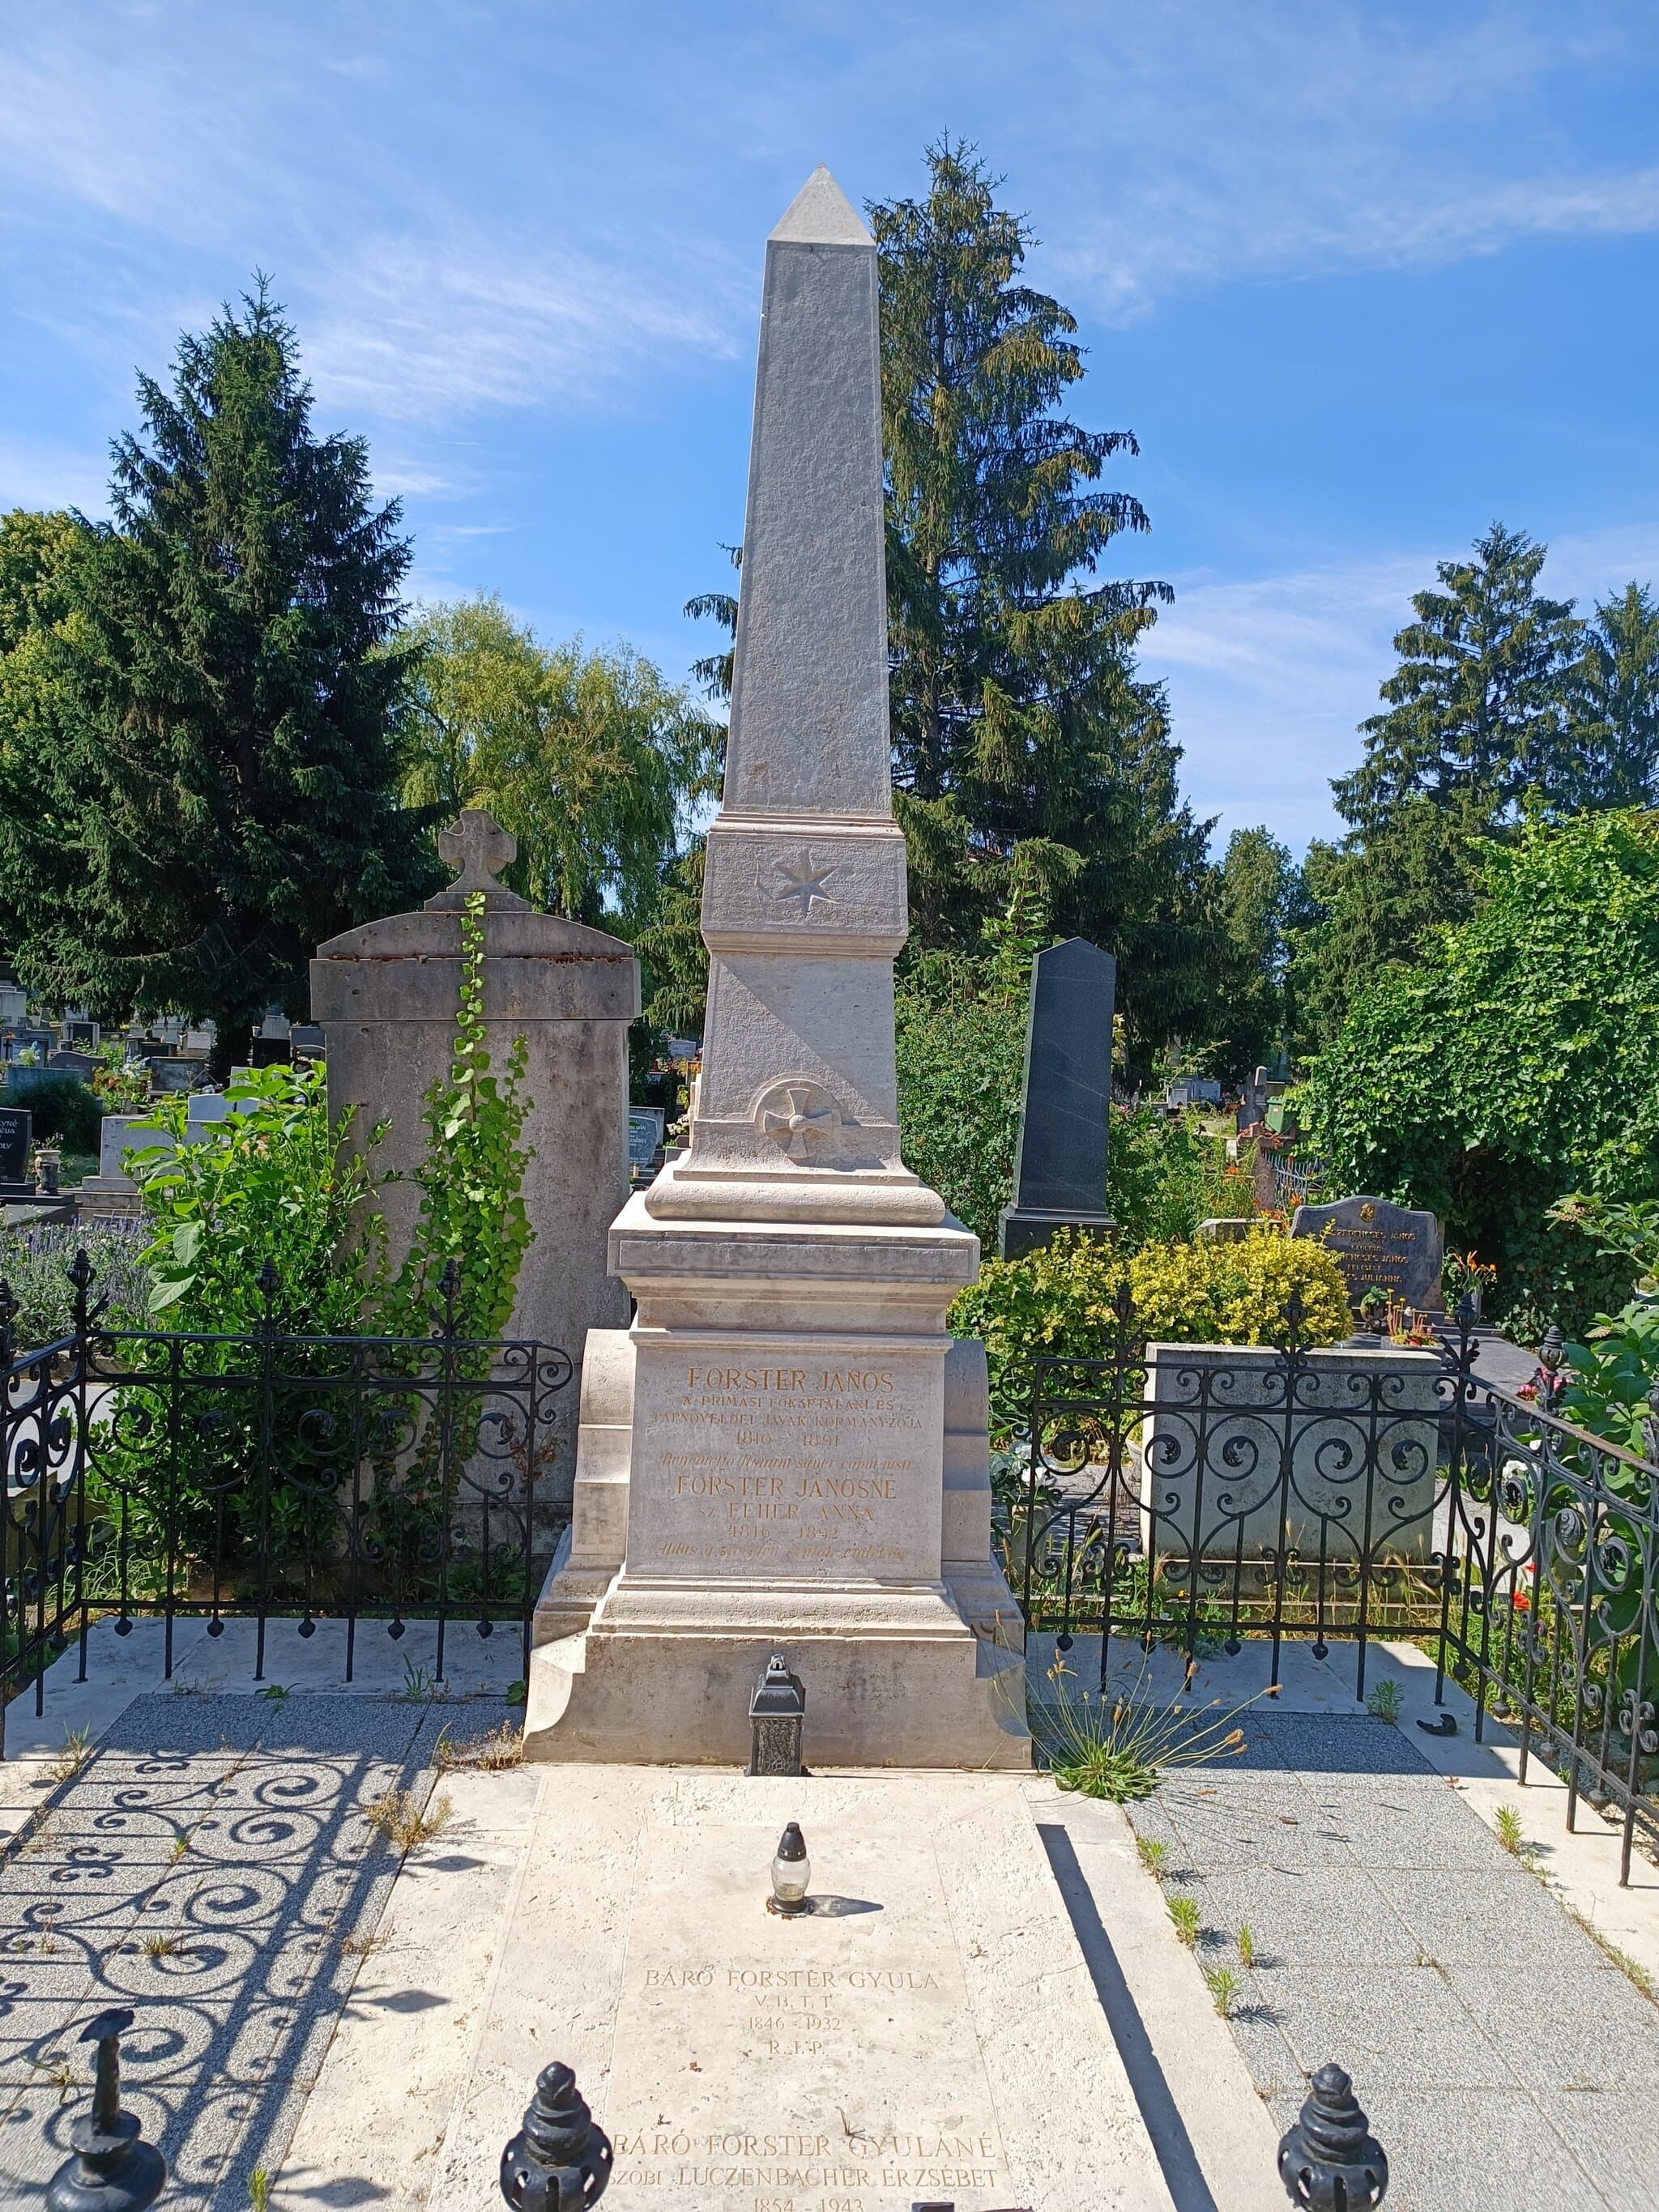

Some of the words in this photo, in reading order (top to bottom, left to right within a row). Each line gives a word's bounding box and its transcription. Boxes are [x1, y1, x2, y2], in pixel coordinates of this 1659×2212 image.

[689, 1366, 806, 1393] FORSTER
[681, 1396, 692, 1406] A
[676, 1476, 784, 1497] FORSTER
[821, 1504, 874, 1521] ANNA
[646, 1964, 714, 1987] BÁRÓ
[728, 1970, 837, 1988] FORSTER
[849, 1971, 940, 1989] GYULA
[748, 2017, 785, 2031] 1846
[806, 2017, 842, 2031] 1932
[613, 2129, 690, 2156] BÁRÓ
[706, 2134, 832, 2157] FORSTER
[848, 2131, 997, 2158] GYULÁNÉ
[608, 2171, 662, 2186] SZOBI
[678, 2167, 870, 2188] LUCZENBACHER
[882, 2164, 998, 2188] ERZSÉBET
[754, 2197, 794, 2212] 1854
[820, 2198, 864, 2212] 1943
